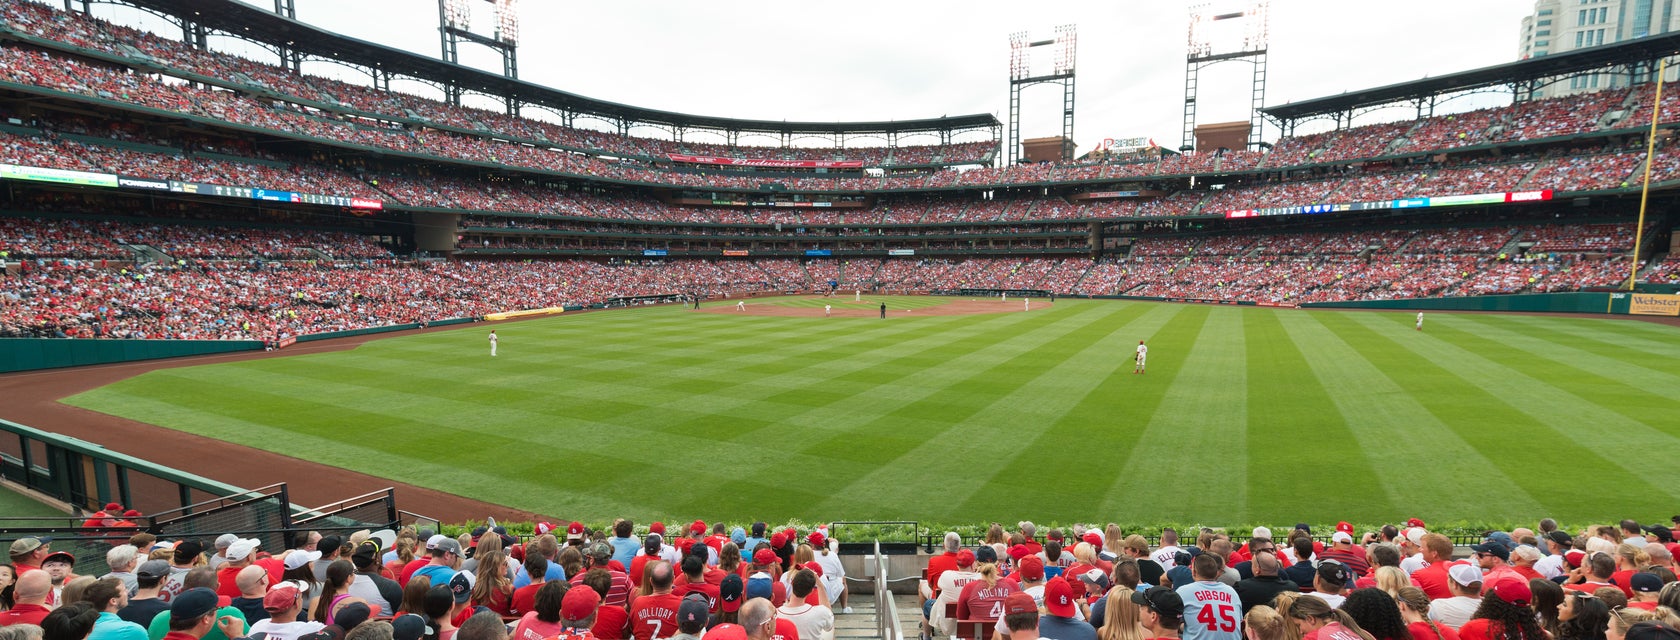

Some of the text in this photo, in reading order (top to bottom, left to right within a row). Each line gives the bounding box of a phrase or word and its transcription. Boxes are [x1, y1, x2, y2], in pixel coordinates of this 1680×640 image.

[732, 157, 804, 167] Budweiser
[1633, 296, 1677, 306] Webster
[978, 588, 1009, 600] MOLINA
[1195, 591, 1232, 603] GIBSON
[637, 607, 674, 620] HOLLIDAY
[989, 601, 1000, 618] 4
[1197, 604, 1236, 633] 45
[646, 619, 662, 640] 7
